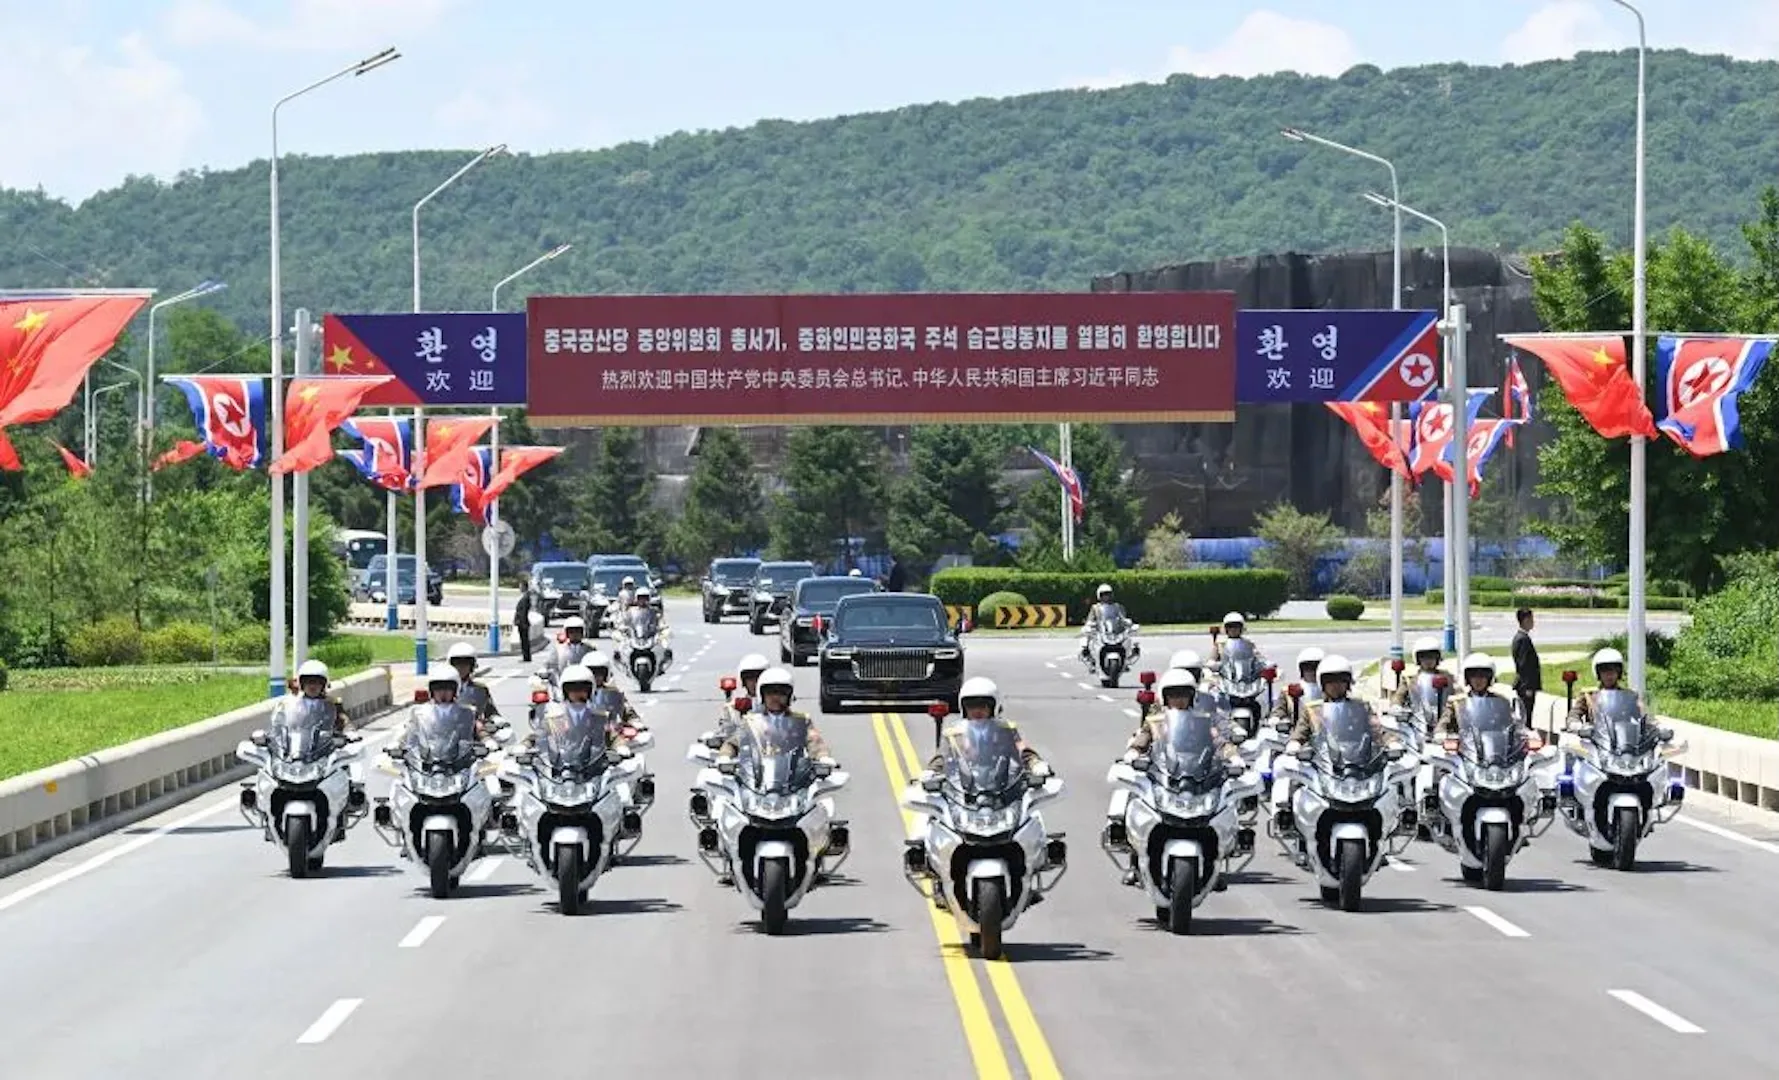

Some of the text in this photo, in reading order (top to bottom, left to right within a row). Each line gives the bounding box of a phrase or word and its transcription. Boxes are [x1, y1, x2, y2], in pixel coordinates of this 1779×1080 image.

[544, 324, 1221, 353] 중국공산당 중앙위원회 총서기, 중화인민공화국 주석 습근평동지를 열렬히 환영합니다
